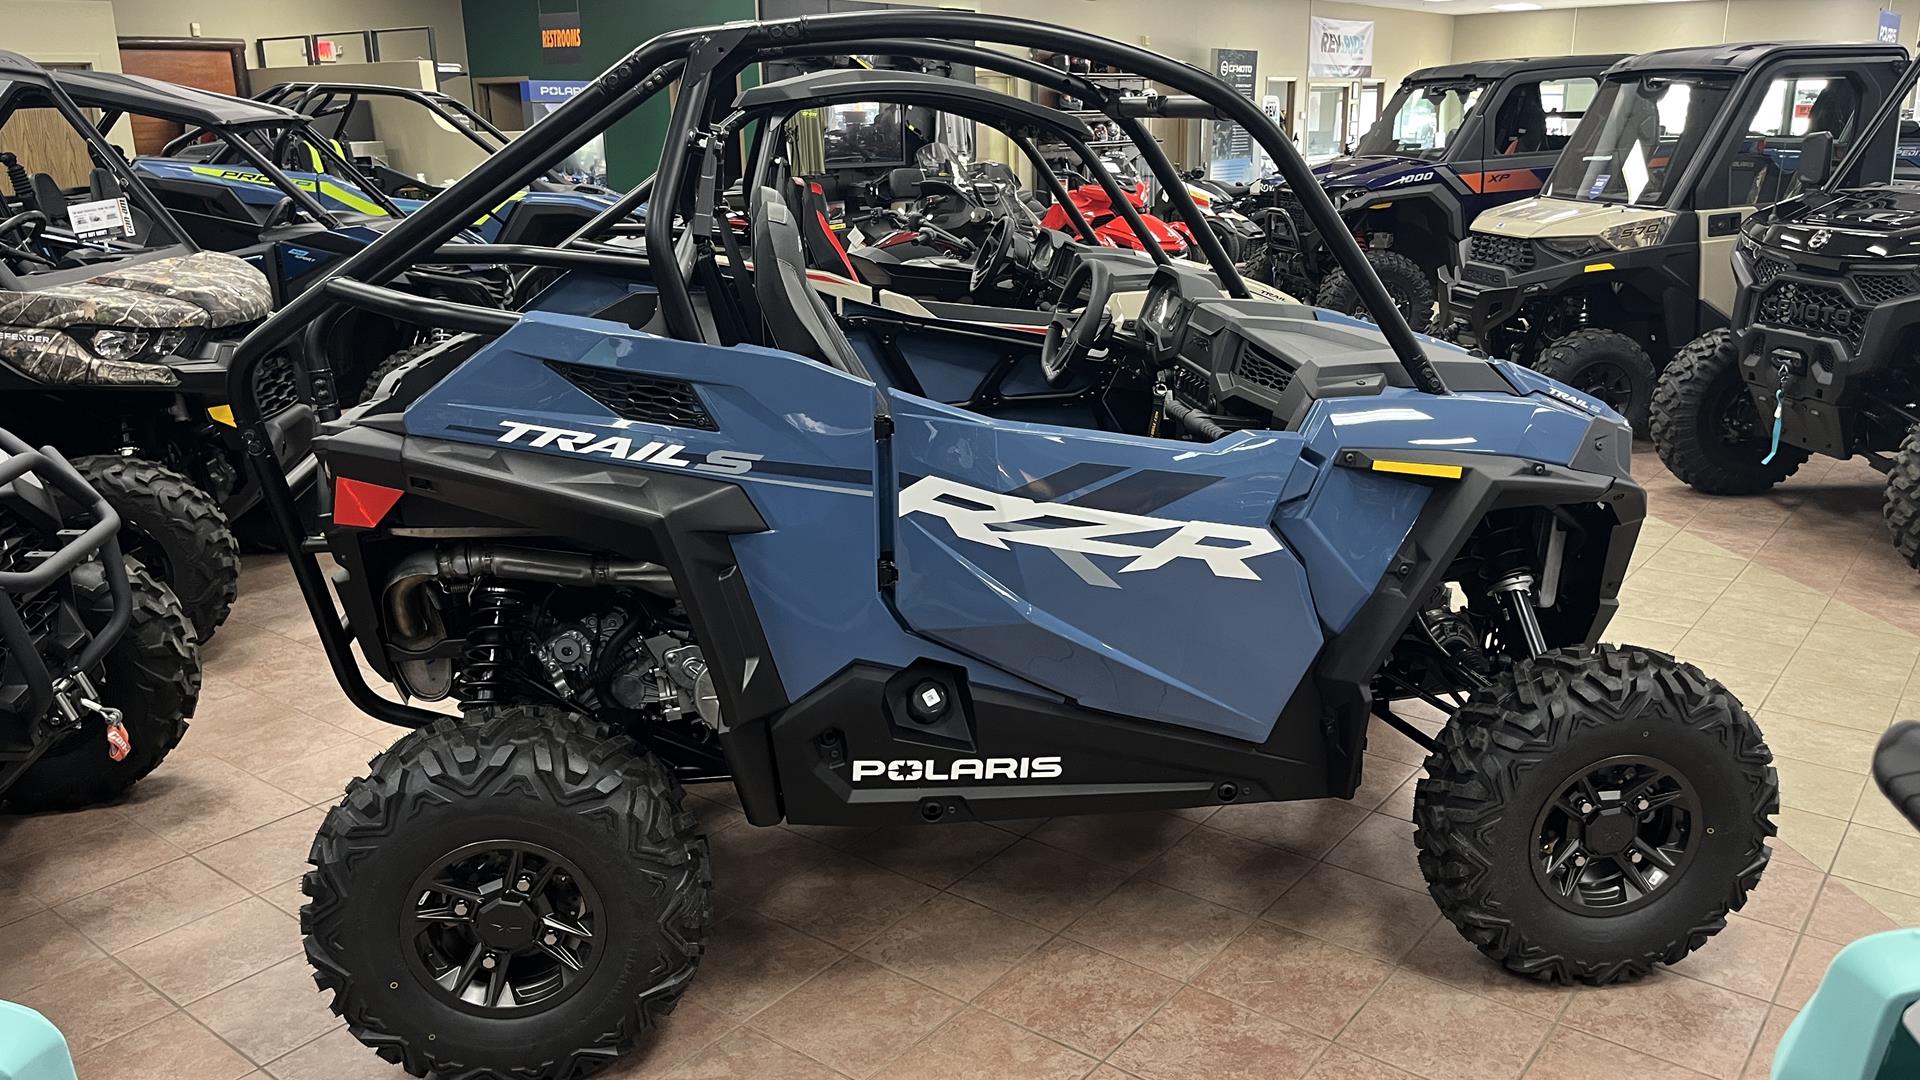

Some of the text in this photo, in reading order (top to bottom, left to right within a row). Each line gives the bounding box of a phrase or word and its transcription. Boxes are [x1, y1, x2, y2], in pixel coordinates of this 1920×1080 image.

[542, 28, 581, 48] RESTROOMS
[1401, 172, 1434, 184] 1000
[1488, 174, 1511, 183] XP
[1620, 224, 1660, 239] 570
[1760, 296, 1852, 326] CFMOTO
[1549, 387, 1602, 414] TRAIL S
[497, 420, 764, 475] TRAIL S
[898, 474, 1284, 582] RZR
[852, 756, 1062, 782] POLARIS
